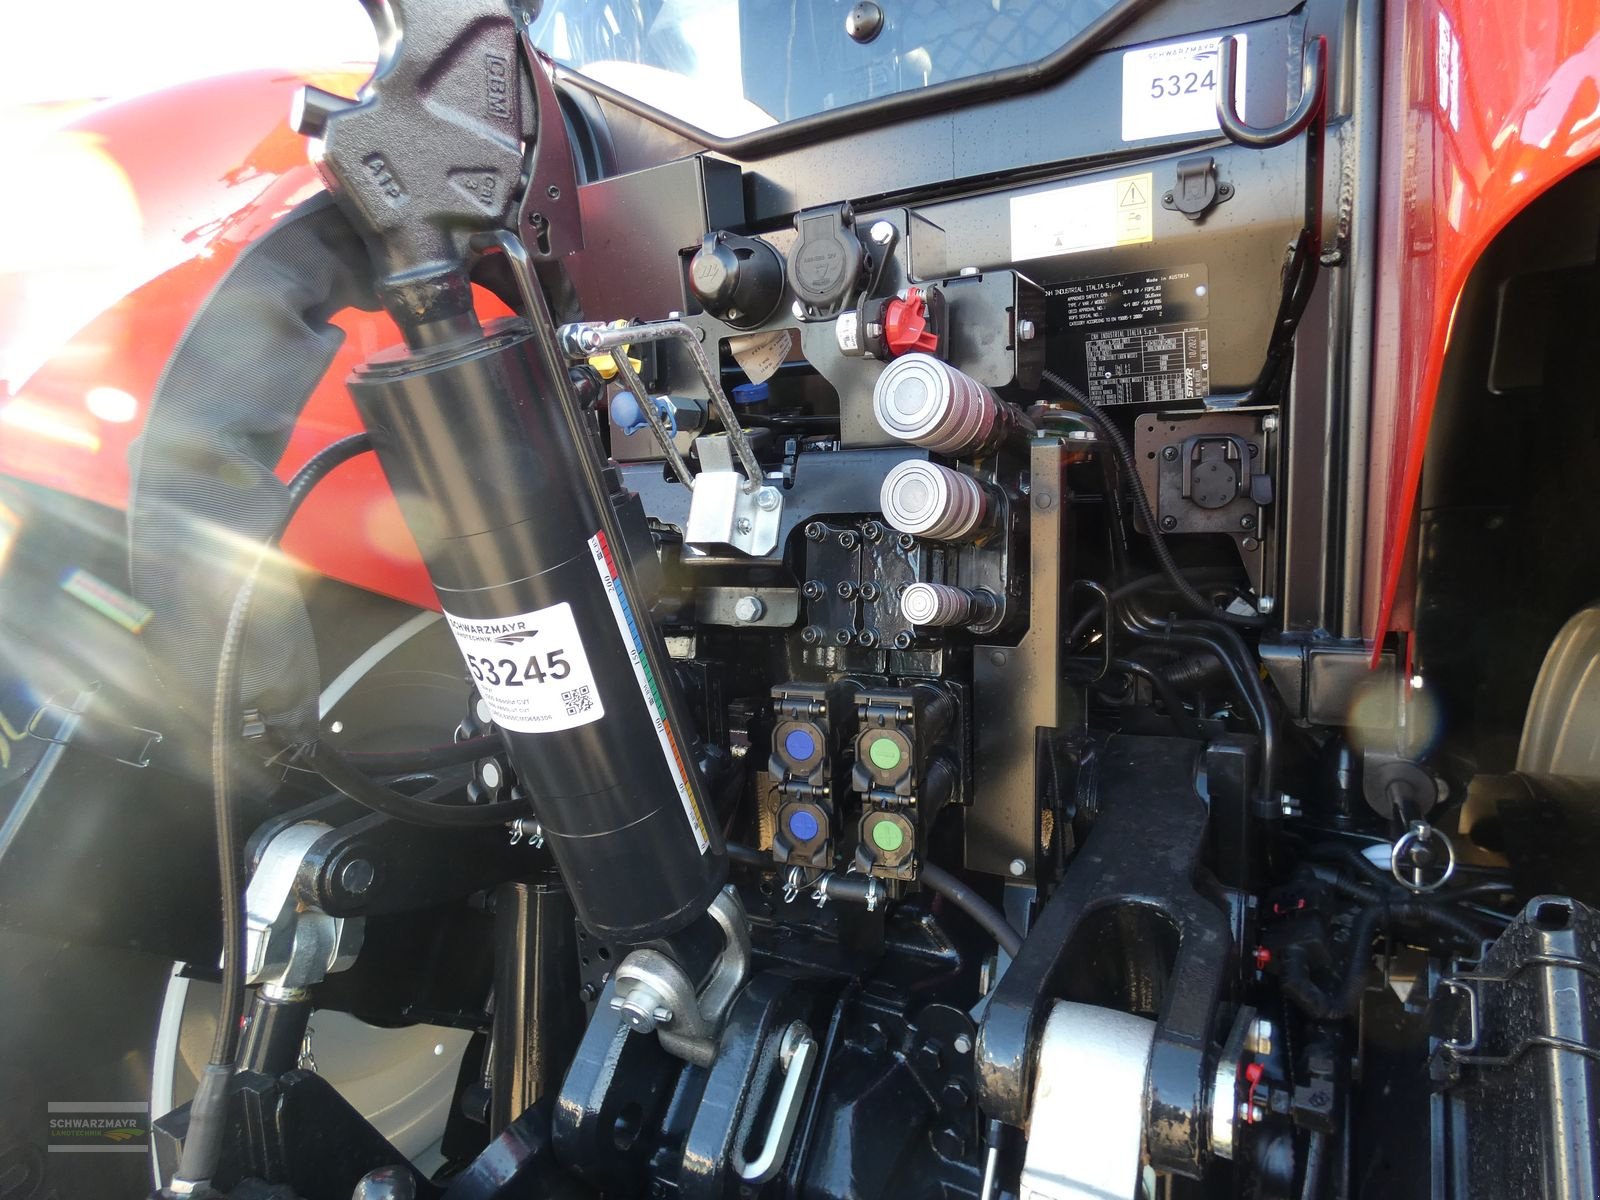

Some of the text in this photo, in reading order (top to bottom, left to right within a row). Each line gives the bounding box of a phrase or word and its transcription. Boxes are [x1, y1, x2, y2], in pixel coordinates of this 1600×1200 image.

[1151, 69, 1217, 99] 5324
[1168, 272, 1190, 280] AUSTRIA
[1085, 283, 1104, 292] ITALIA
[1185, 368, 1194, 398] STEYR
[604, 575, 615, 593] 200
[449, 618, 527, 635] SCHWARZMAYR
[630, 649, 641, 666] 150
[466, 648, 571, 687] 53245
[655, 717, 665, 733] 100
